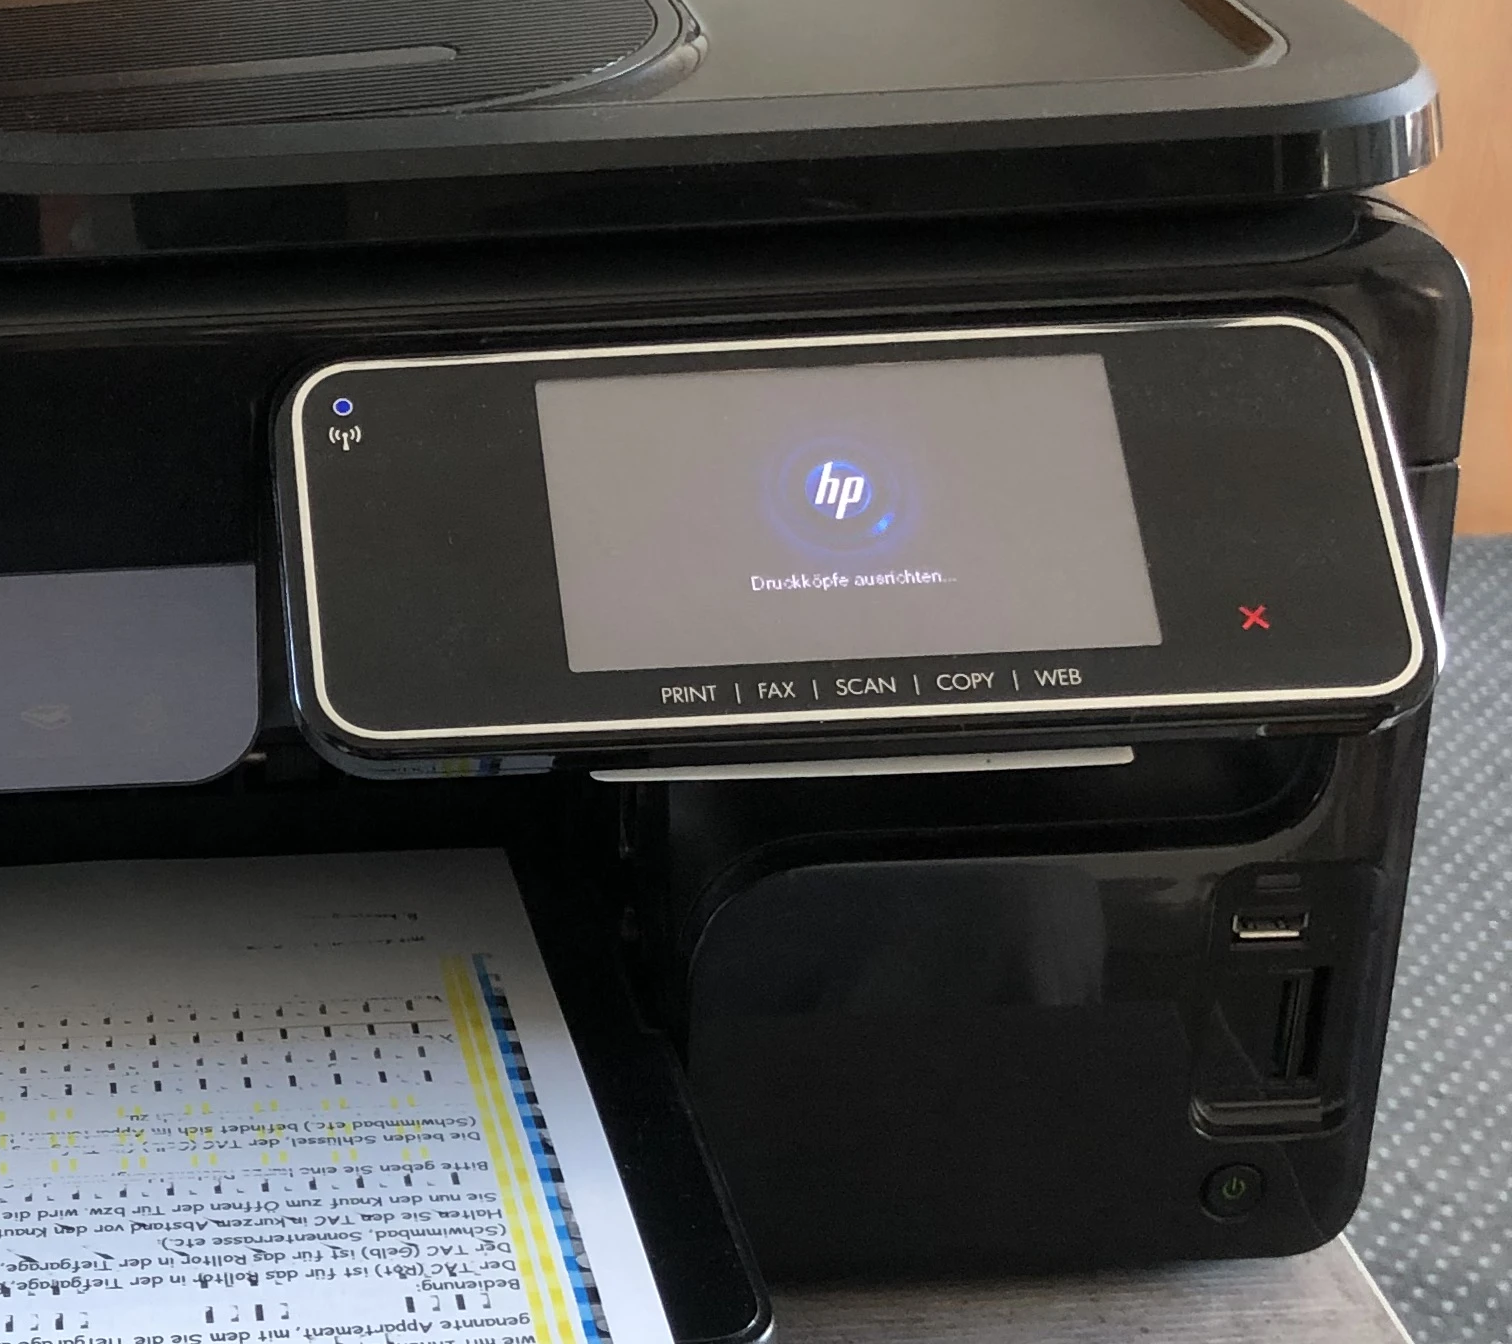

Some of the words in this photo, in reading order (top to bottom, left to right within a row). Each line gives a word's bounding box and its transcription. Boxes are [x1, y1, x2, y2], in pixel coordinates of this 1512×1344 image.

[813, 460, 865, 520] hp
[750, 572, 849, 592] Druckköpfe
[661, 684, 717, 704] PRINT
[758, 681, 797, 700] FAX
[835, 677, 897, 697] SCAN
[936, 671, 995, 691] COPY
[1034, 669, 1083, 687] WEB
[220, 1121, 298, 1136] befindet
[303, 1119, 346, 1133] etc.)
[352, 1115, 477, 1131] (Schwimmbad
[178, 1126, 213, 1138] sich
[383, 1132, 445, 1145] beiden
[450, 1130, 480, 1142] Die
[248, 1137, 280, 1149] der
[286, 1134, 376, 1148] Schlüssel,
[342, 1165, 373, 1178] Sie
[379, 1160, 435, 1175] geben
[442, 1160, 488, 1174] Bitte
[286, 1198, 321, 1209] zum
[329, 1196, 382, 1210] Knauf
[388, 1194, 422, 1207] den
[428, 1193, 460, 1204] nun
[466, 1192, 497, 1205] Sie
[84, 1206, 126, 1219] bzw.
[132, 1205, 164, 1218] Tür
[172, 1203, 205, 1216] der
[210, 1200, 280, 1215] Öffnen
[2, 1210, 30, 1223] die
[37, 1208, 78, 1222] wird
[313, 1215, 355, 1227] TAC
[360, 1213, 395, 1227] den
[401, 1211, 432, 1224] Sie
[439, 1208, 502, 1222] Halten
[94, 1224, 124, 1236] vor
[130, 1220, 208, 1235] Abstand
[215, 1217, 285, 1231] kurzem
[53, 1225, 87, 1238] den
[211, 1230, 362, 1247] Sonnenterrasse
[368, 1223, 506, 1242] (Schwimmbad,
[331, 1248, 355, 1261] ist
[361, 1244, 420, 1260] (Gelb)
[427, 1244, 469, 1257] TAC
[475, 1241, 511, 1254] Der
[119, 1257, 152, 1270] der
[182, 1253, 247, 1268] Rolltor
[251, 1251, 286, 1265] das
[291, 1249, 323, 1264] für
[1, 1258, 113, 1276] Tiefgarage,
[345, 1266, 368, 1278] ist
[374, 1263, 424, 1278] (Rot)
[431, 1261, 473, 1275] TAC
[479, 1259, 516, 1272] Der
[193, 1272, 259, 1288] Rolltor
[266, 1270, 298, 1284] das
[302, 1268, 334, 1280] für
[10, 1277, 123, 1295] Tiefgarage,
[130, 1276, 164, 1289] der
[416, 1277, 520, 1293] Bedienung:
[439, 1313, 530, 1331] genannte
[257, 1329, 290, 1342] mit
[295, 1319, 433, 1340] Appartement,
[209, 1330, 250, 1344] dem
